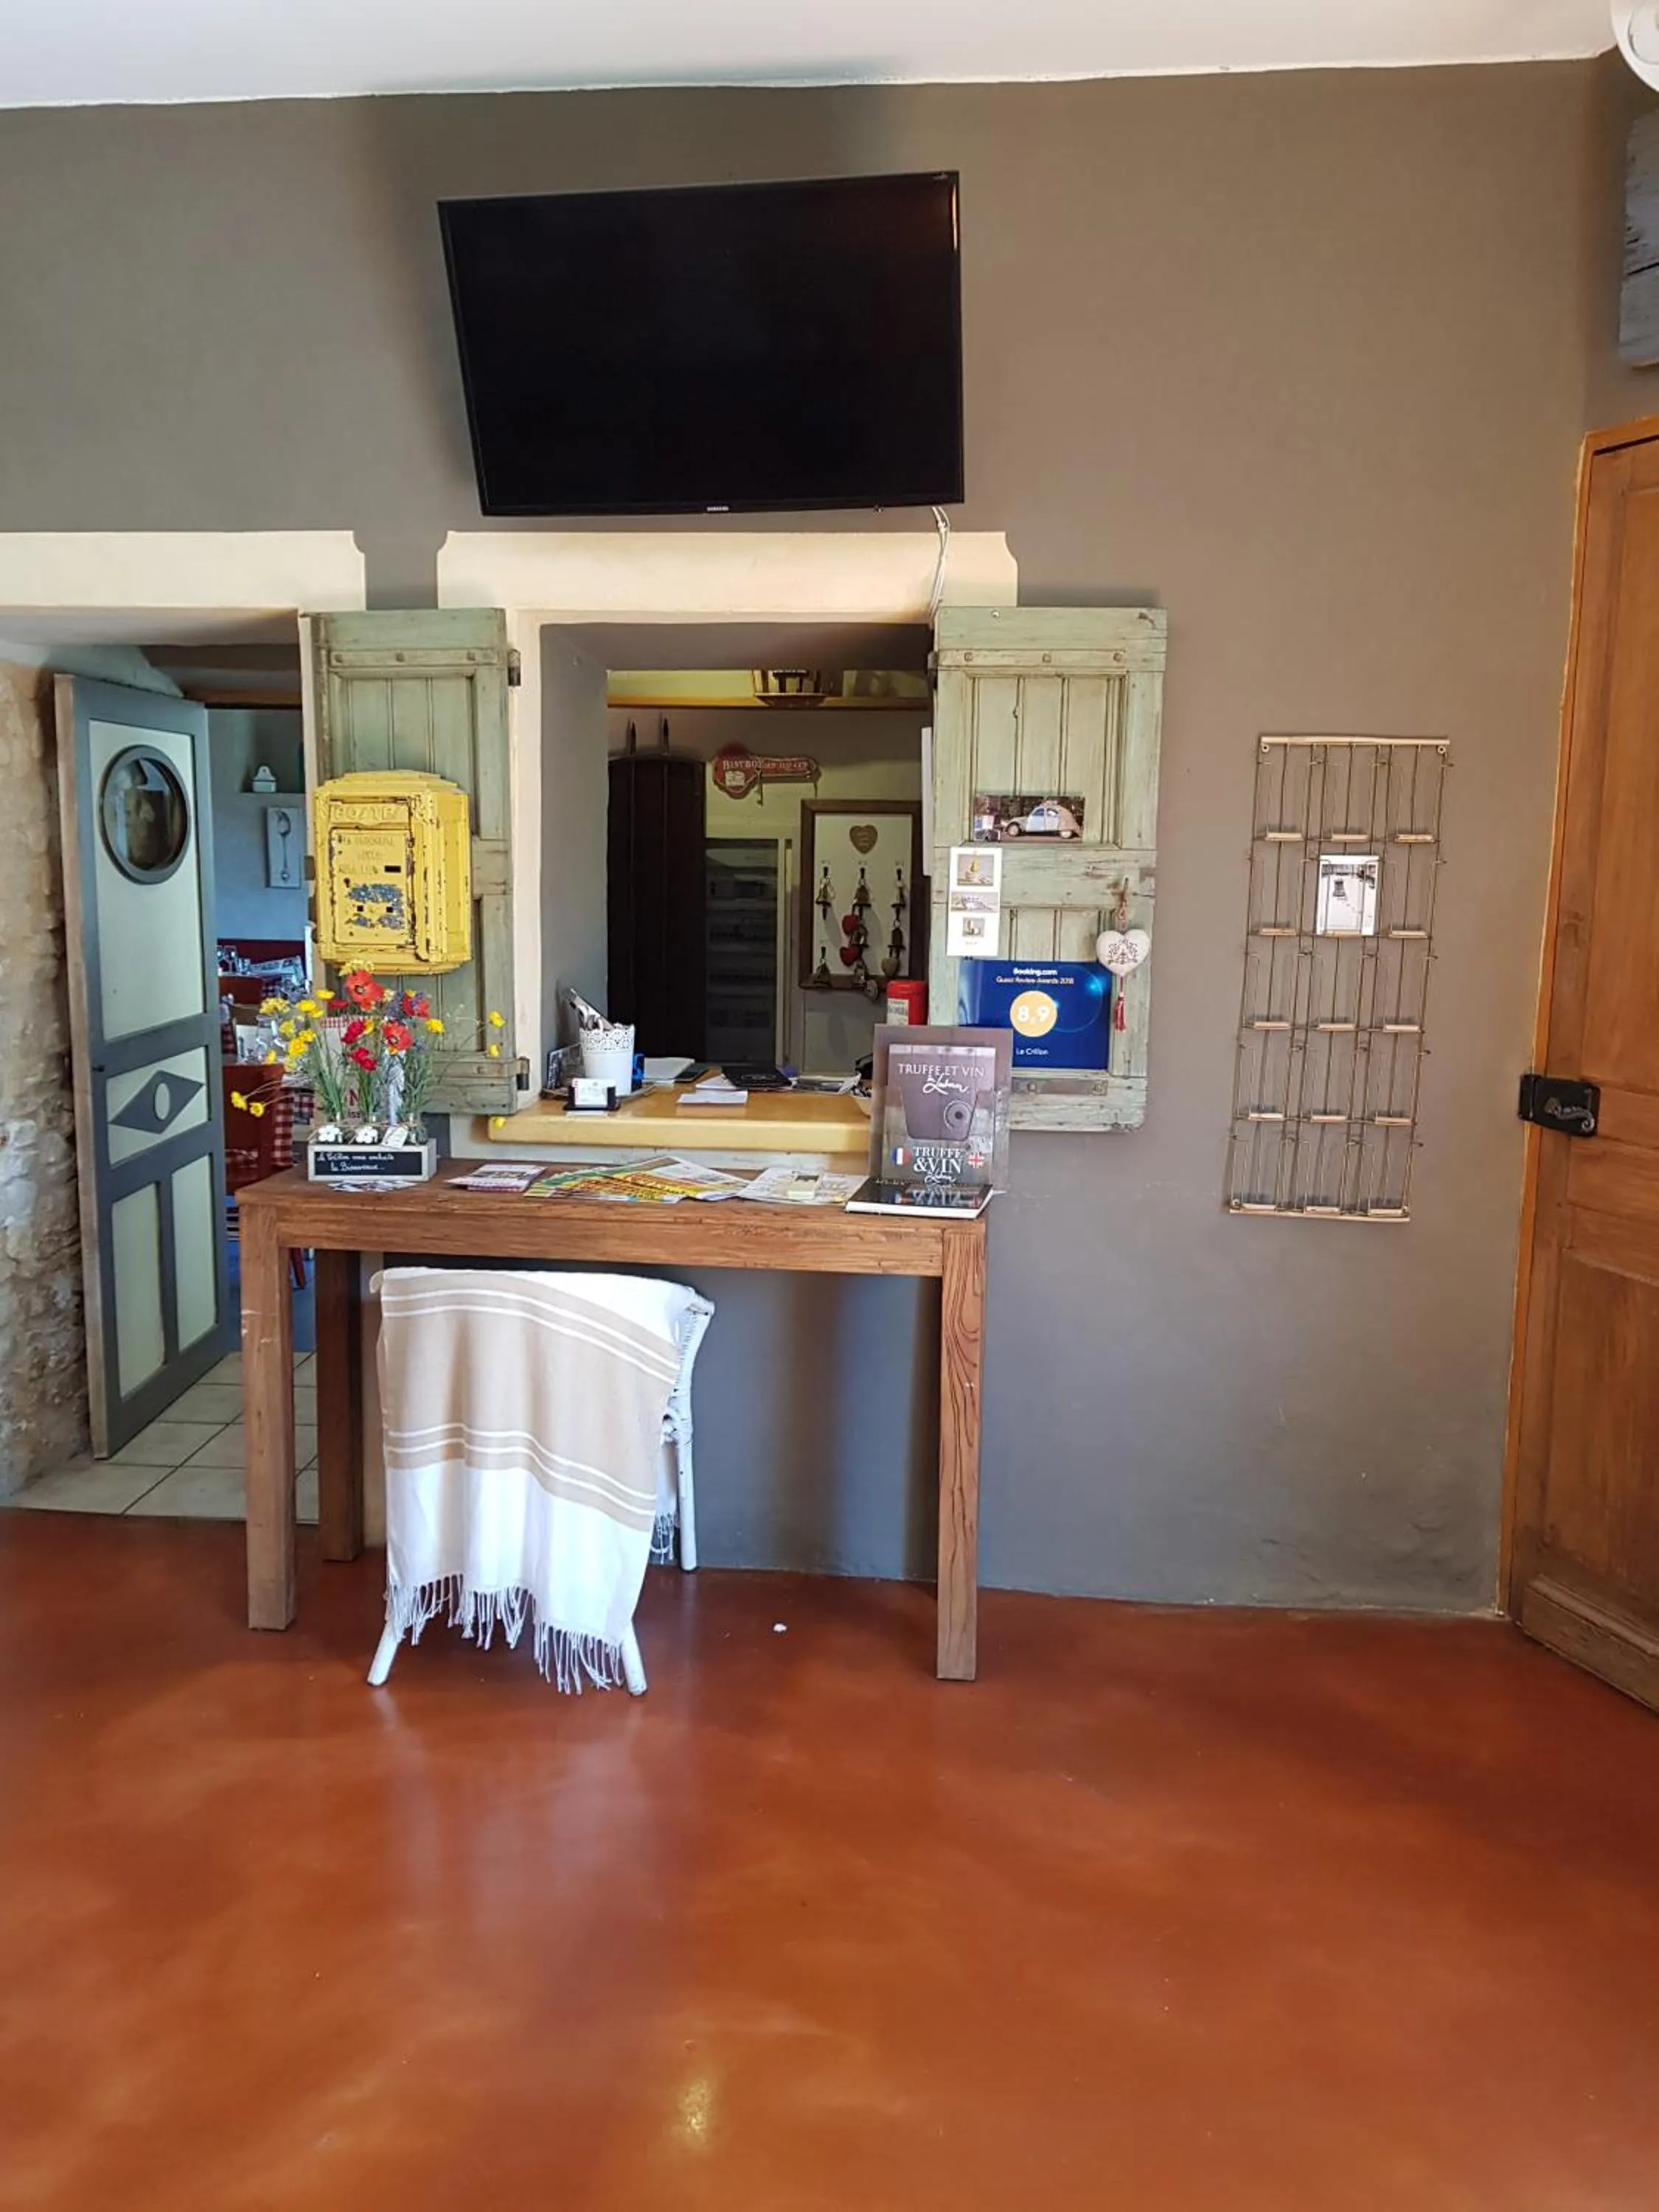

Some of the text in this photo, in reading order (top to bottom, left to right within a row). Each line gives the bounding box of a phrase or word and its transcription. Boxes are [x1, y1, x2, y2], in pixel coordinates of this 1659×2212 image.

[1013, 967, 1058, 976] Booking.com
[898, 1062, 984, 1077] TRUFFE ET VIN
